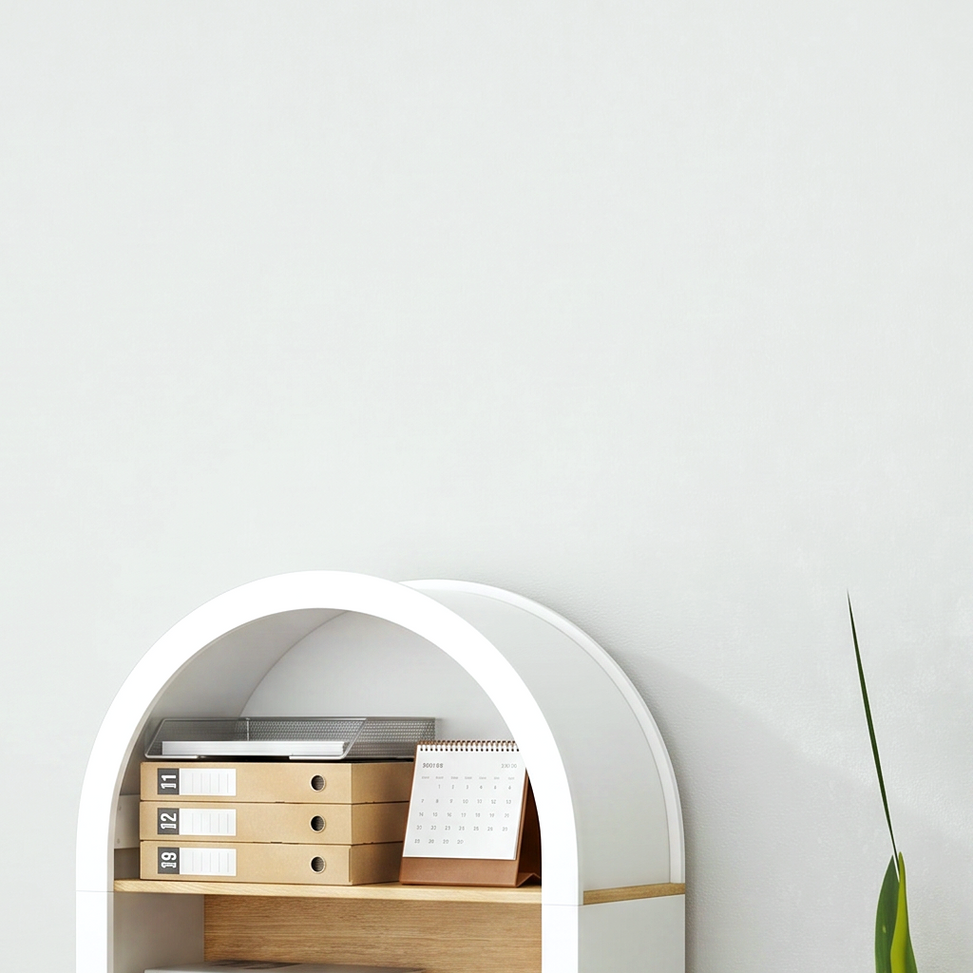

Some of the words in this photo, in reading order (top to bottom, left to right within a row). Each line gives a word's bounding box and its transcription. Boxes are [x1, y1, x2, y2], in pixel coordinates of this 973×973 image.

[160, 774, 177, 789] 11
[160, 813, 177, 829] 12
[160, 852, 177, 869] 19
